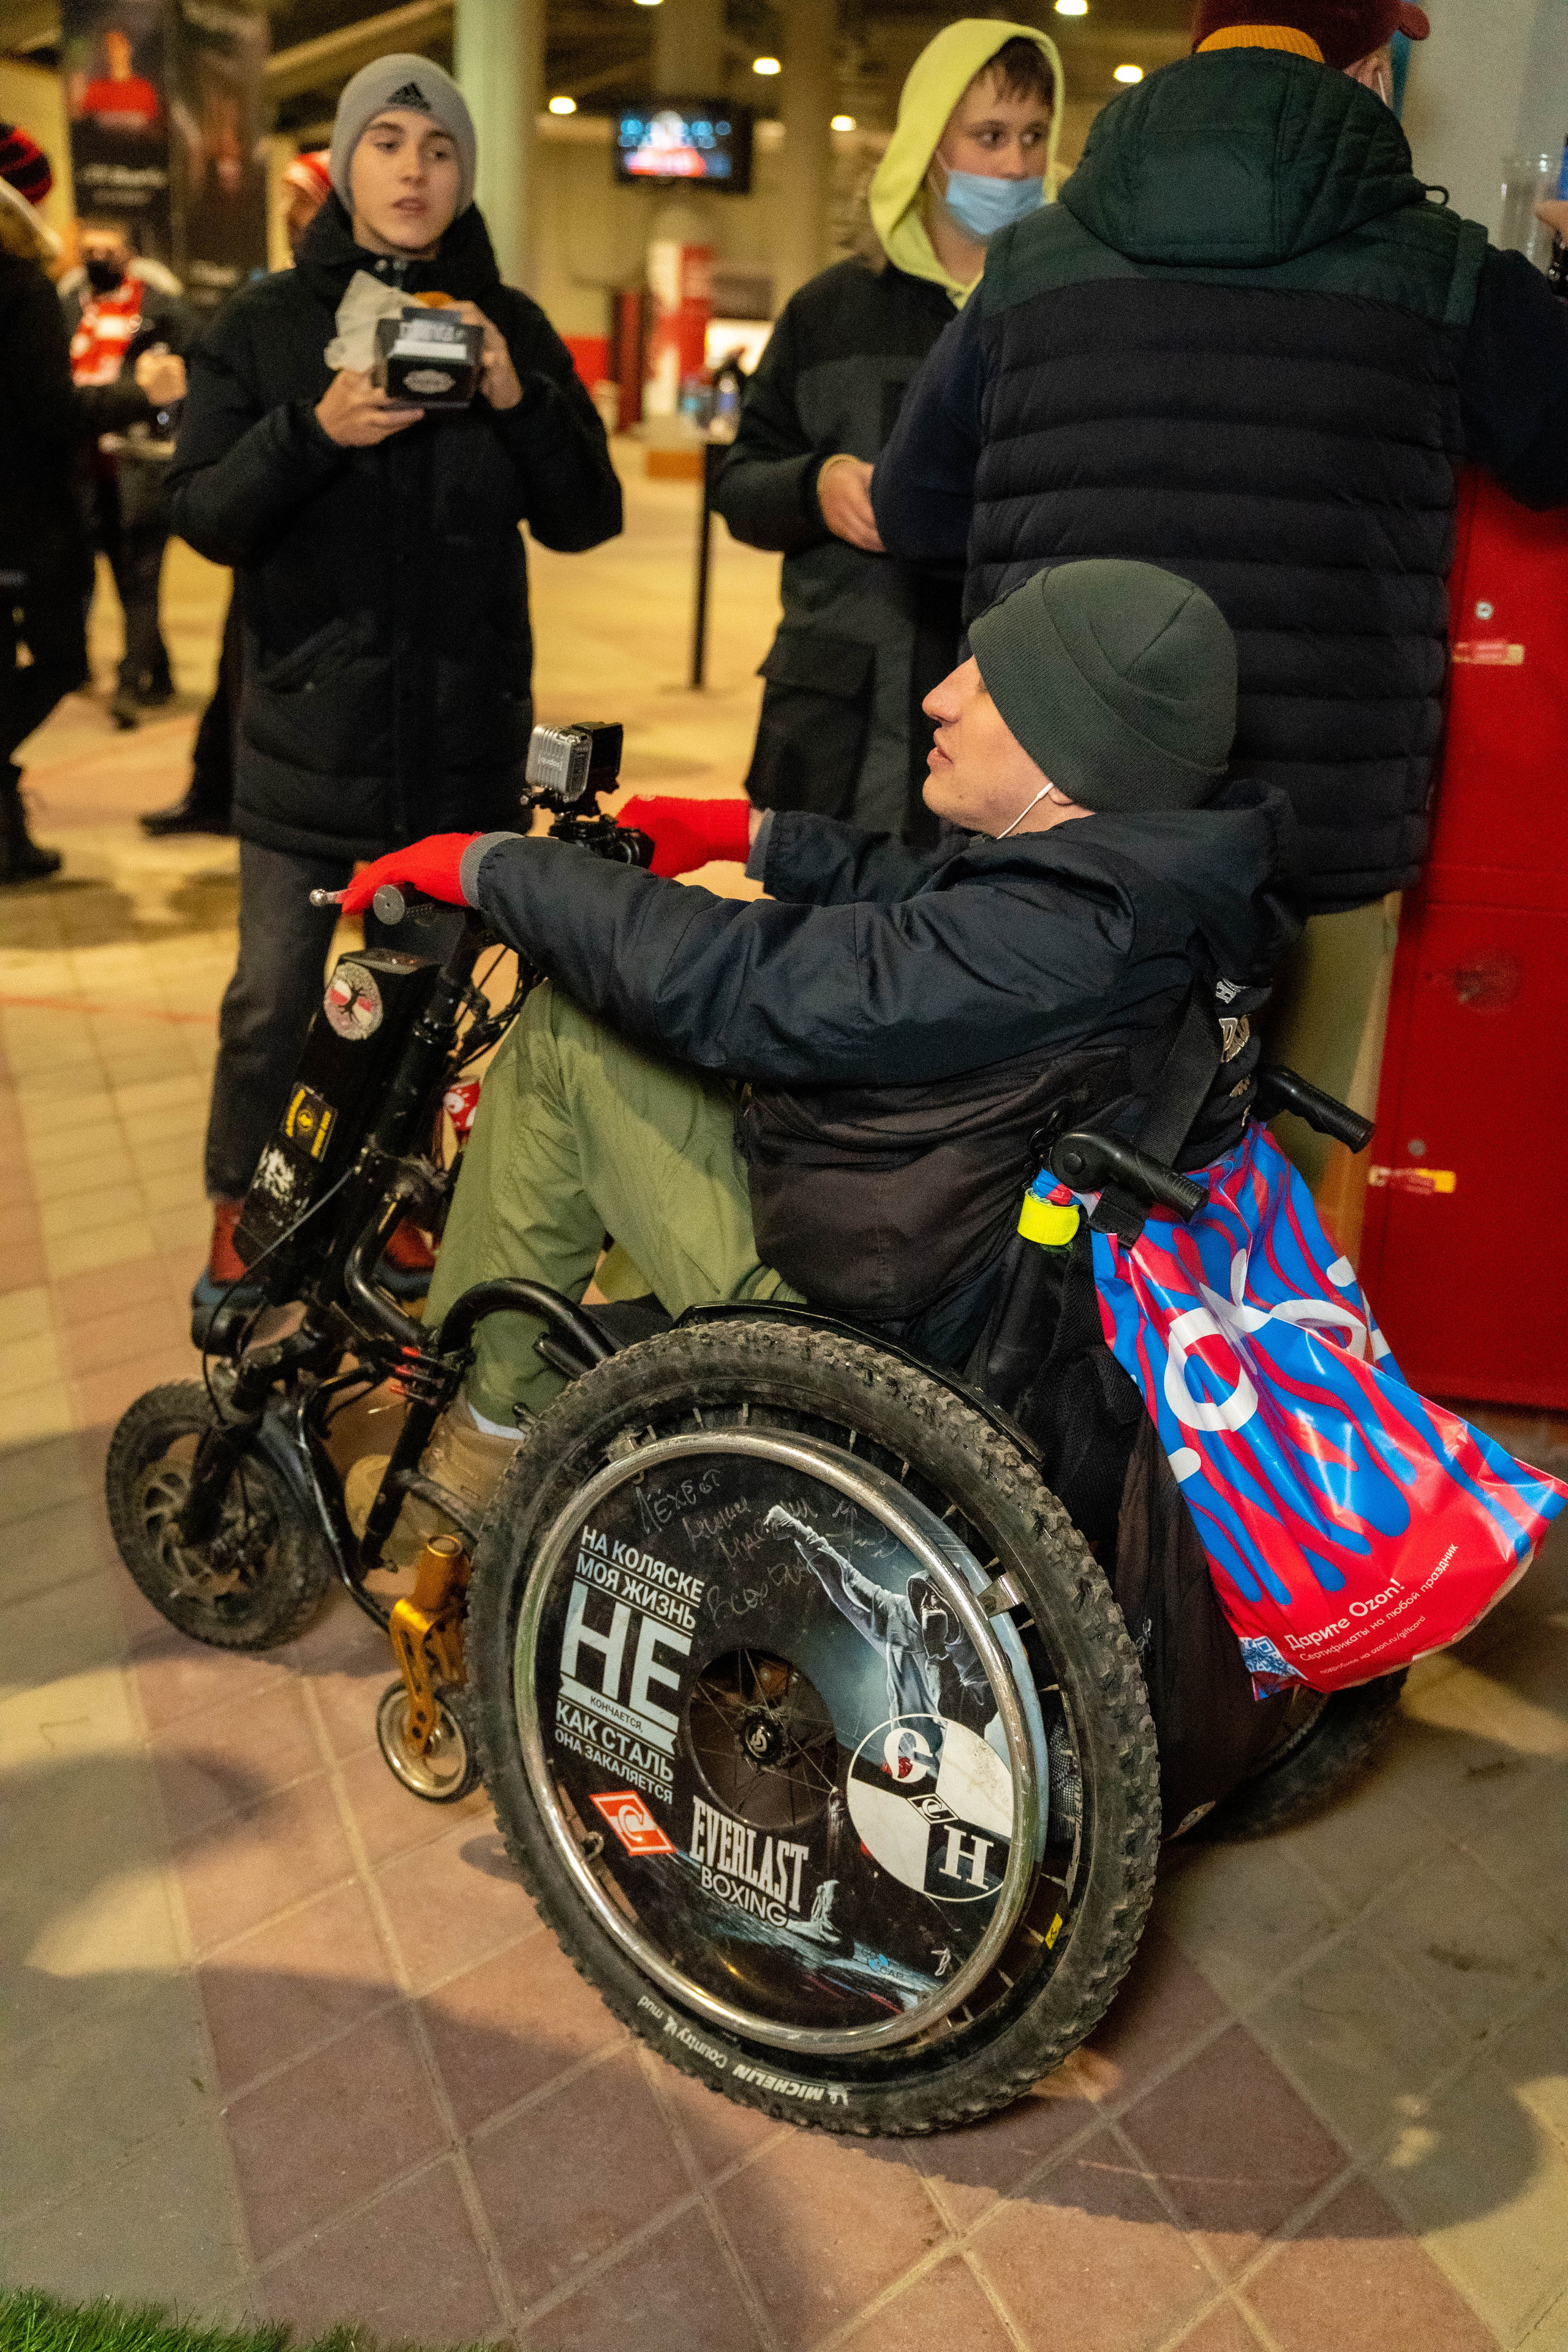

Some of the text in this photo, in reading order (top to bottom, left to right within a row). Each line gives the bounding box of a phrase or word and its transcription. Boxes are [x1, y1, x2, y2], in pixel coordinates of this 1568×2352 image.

[575, 1553, 620, 1592] МОЯ
[621, 1575, 696, 1630] ЖИЗНЬ
[581, 1525, 608, 1556] НА
[611, 1540, 705, 1603] КОЛЯСКЕ
[1299, 1544, 1459, 1661] Сертификаты на любой праздник
[1284, 1578, 1405, 1651] Дарите Ozon!
[1370, 1615, 1427, 1654] ozon.ru/giftcard
[560, 1580, 692, 1733] НЕ
[555, 1700, 674, 1782] КАК СТАЛЬ
[590, 1695, 644, 1733] КОНЧАЕТСЯ,
[554, 1728, 673, 1805] ОНА ЗАКАЛЯЕТСЯ
[689, 1795, 809, 1913] EVERLAST
[701, 1865, 788, 1928] BOXING
[637, 1996, 825, 2101] MICHELIN Country mud
